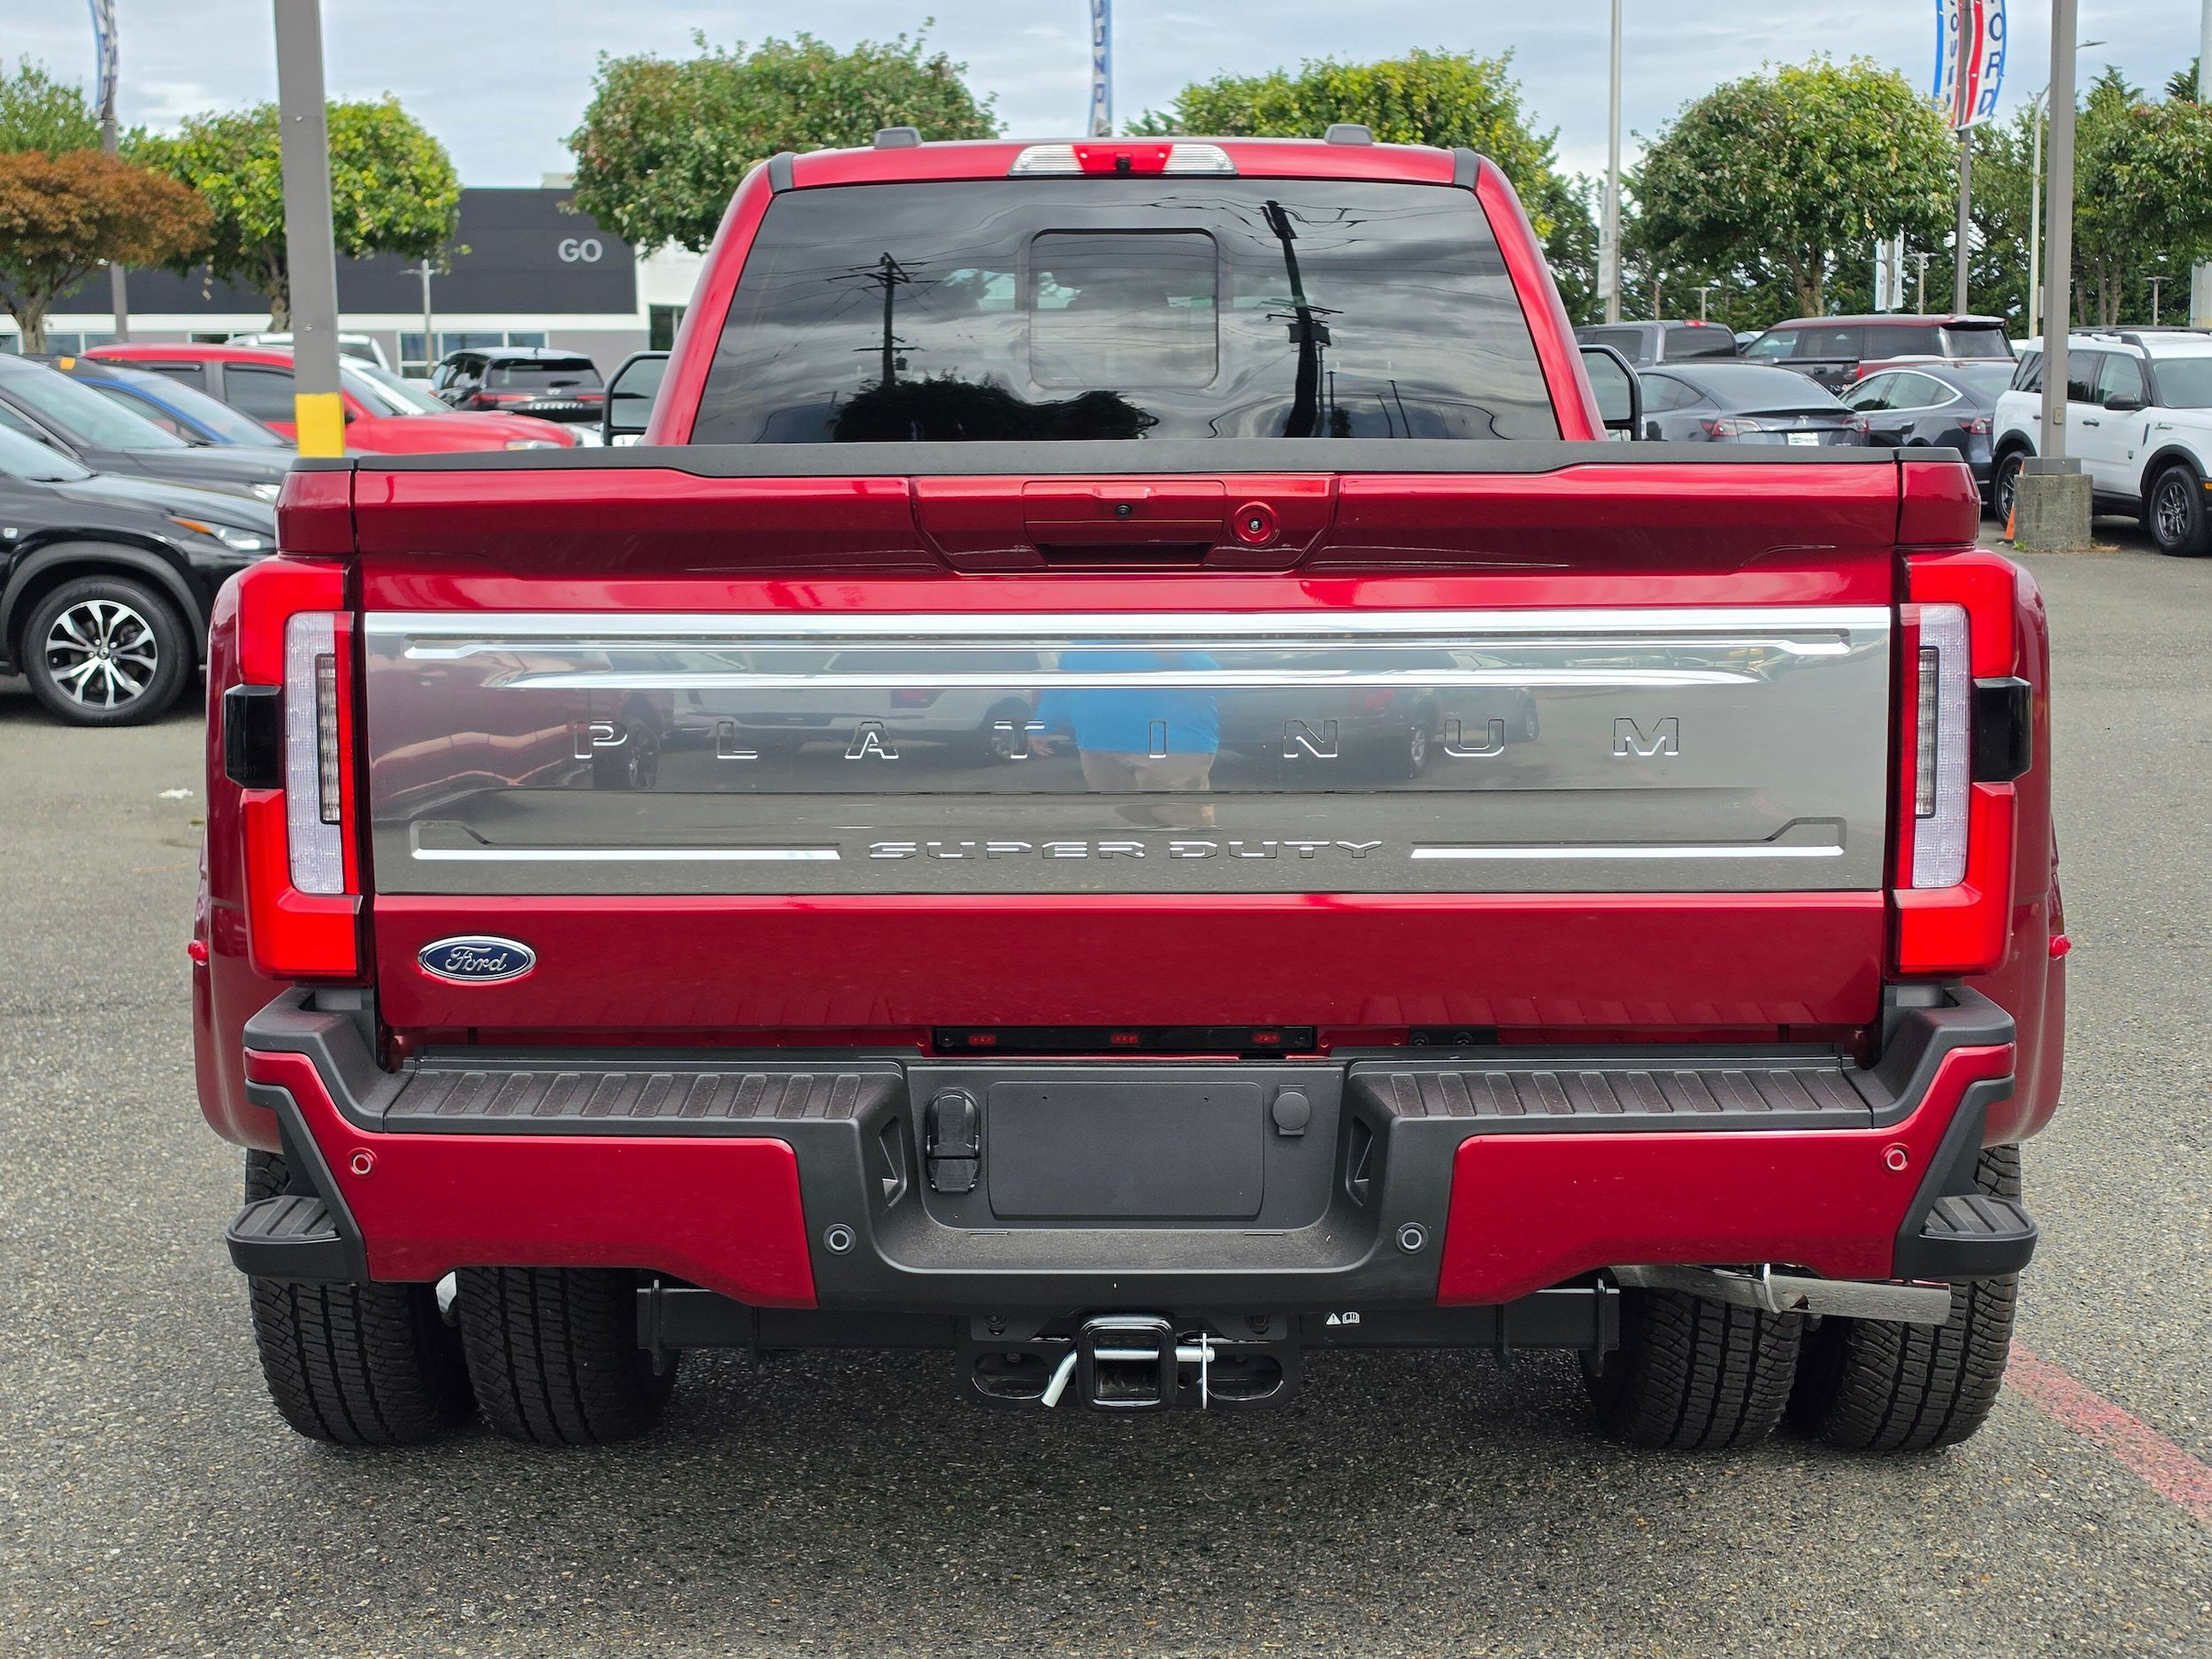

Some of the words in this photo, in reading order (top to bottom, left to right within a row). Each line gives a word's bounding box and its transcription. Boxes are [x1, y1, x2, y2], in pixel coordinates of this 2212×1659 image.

[1978, 0, 2005, 118] ORD
[557, 238, 603, 263] GO
[573, 717, 1680, 760] PLATINUM
[869, 840, 1147, 860] SUPER
[1169, 840, 1384, 860] DUTY
[444, 945, 508, 972] Ford
